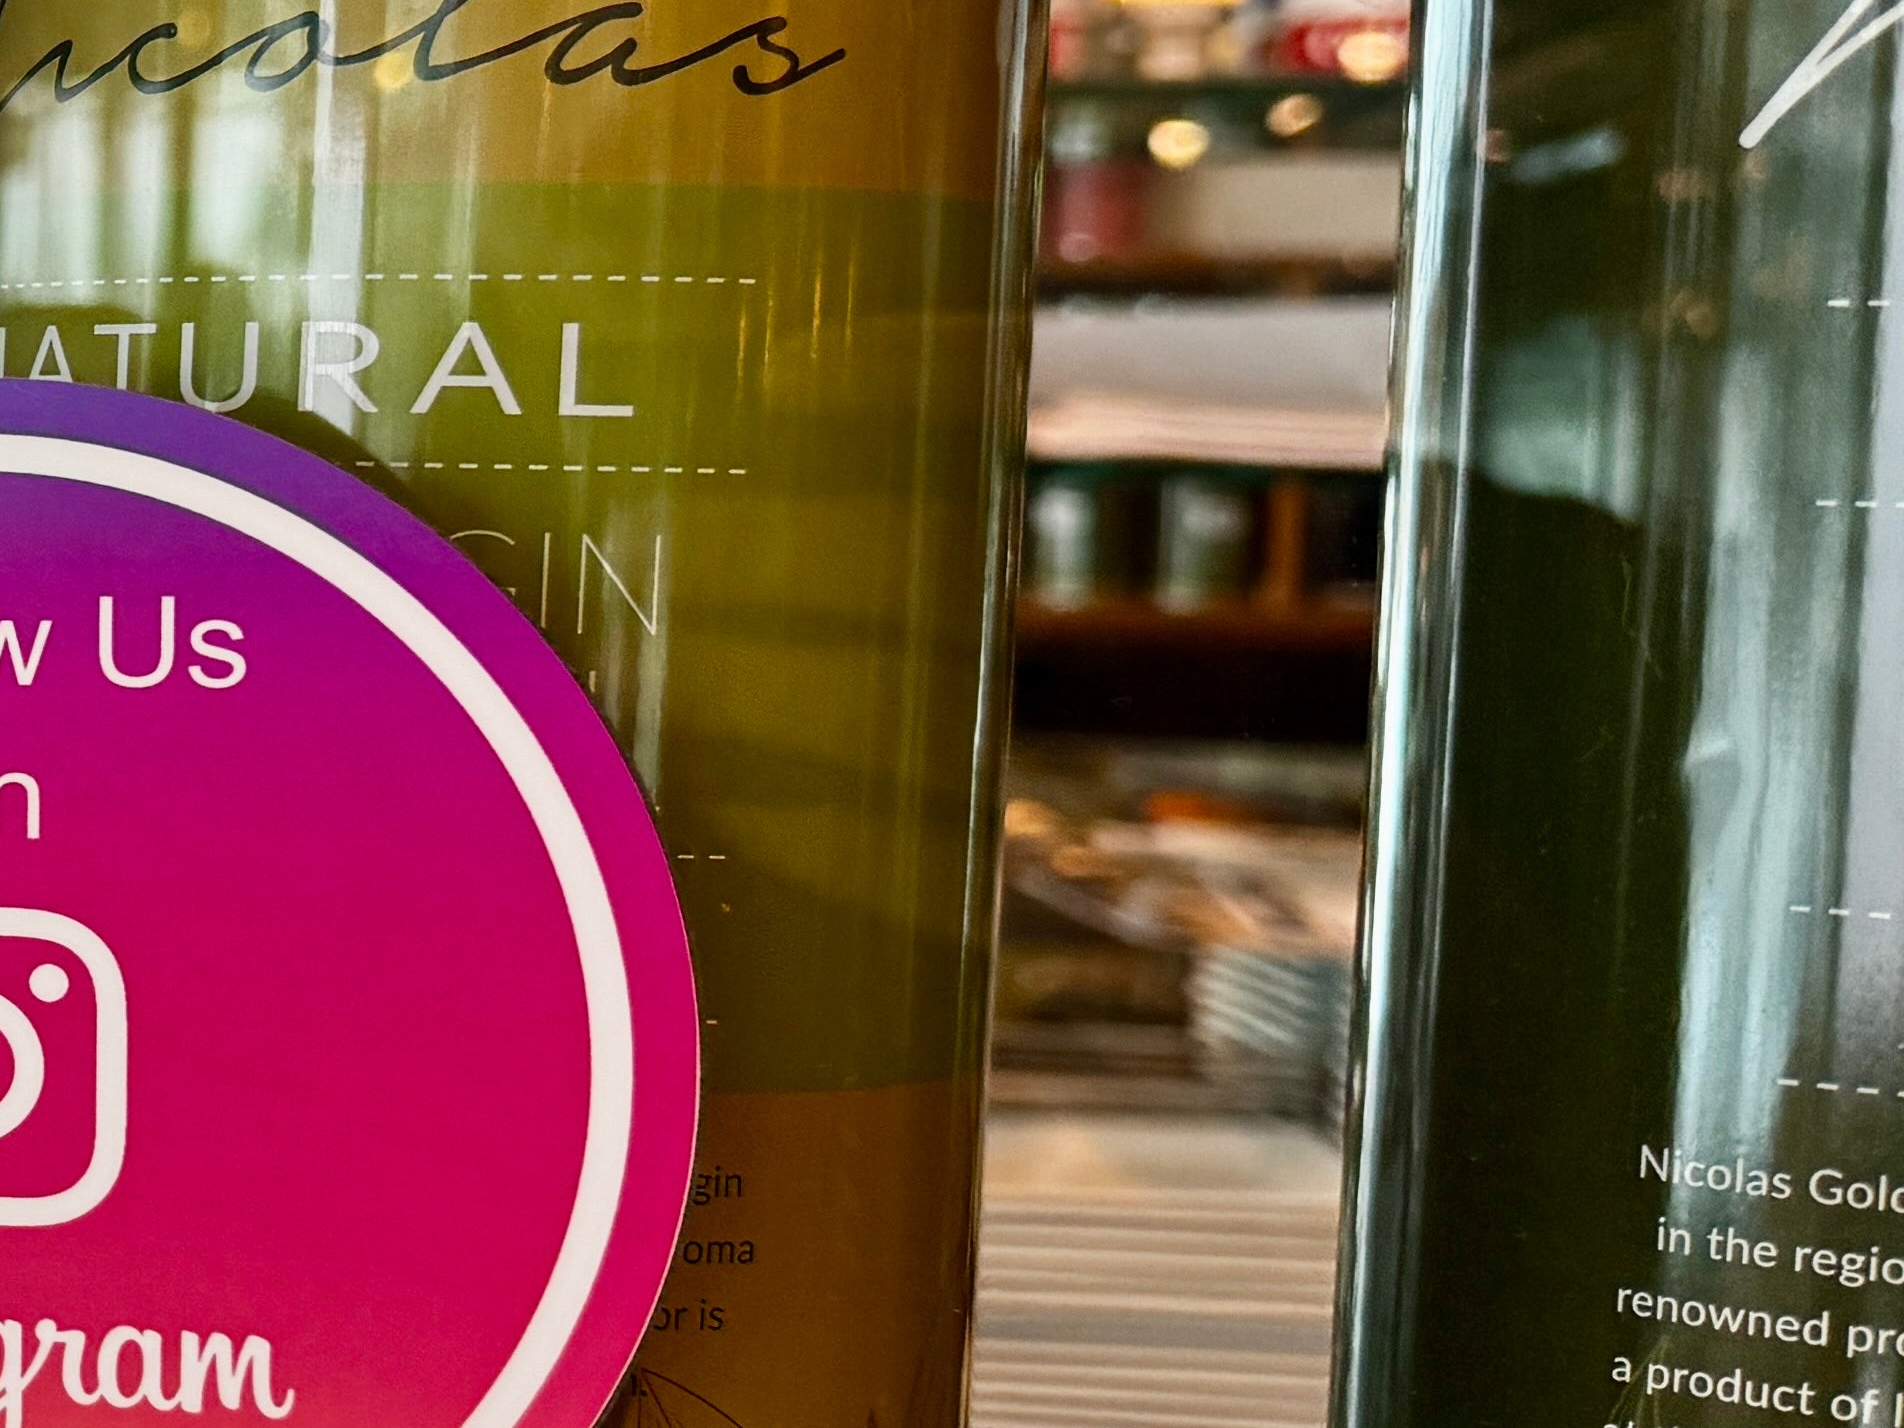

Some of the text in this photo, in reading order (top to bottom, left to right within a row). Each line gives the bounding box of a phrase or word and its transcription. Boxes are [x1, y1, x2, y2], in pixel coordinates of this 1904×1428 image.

[98, 595, 248, 689] Us
[1639, 1143, 1793, 1201] Nicolas
[1656, 1216, 1904, 1289] in the regio
[699, 1298, 727, 1333] is
[1616, 1285, 1830, 1348] renowned
[1611, 1355, 1633, 1384] a
[1645, 1361, 1816, 1417] product
[1830, 1388, 1880, 1425] of
